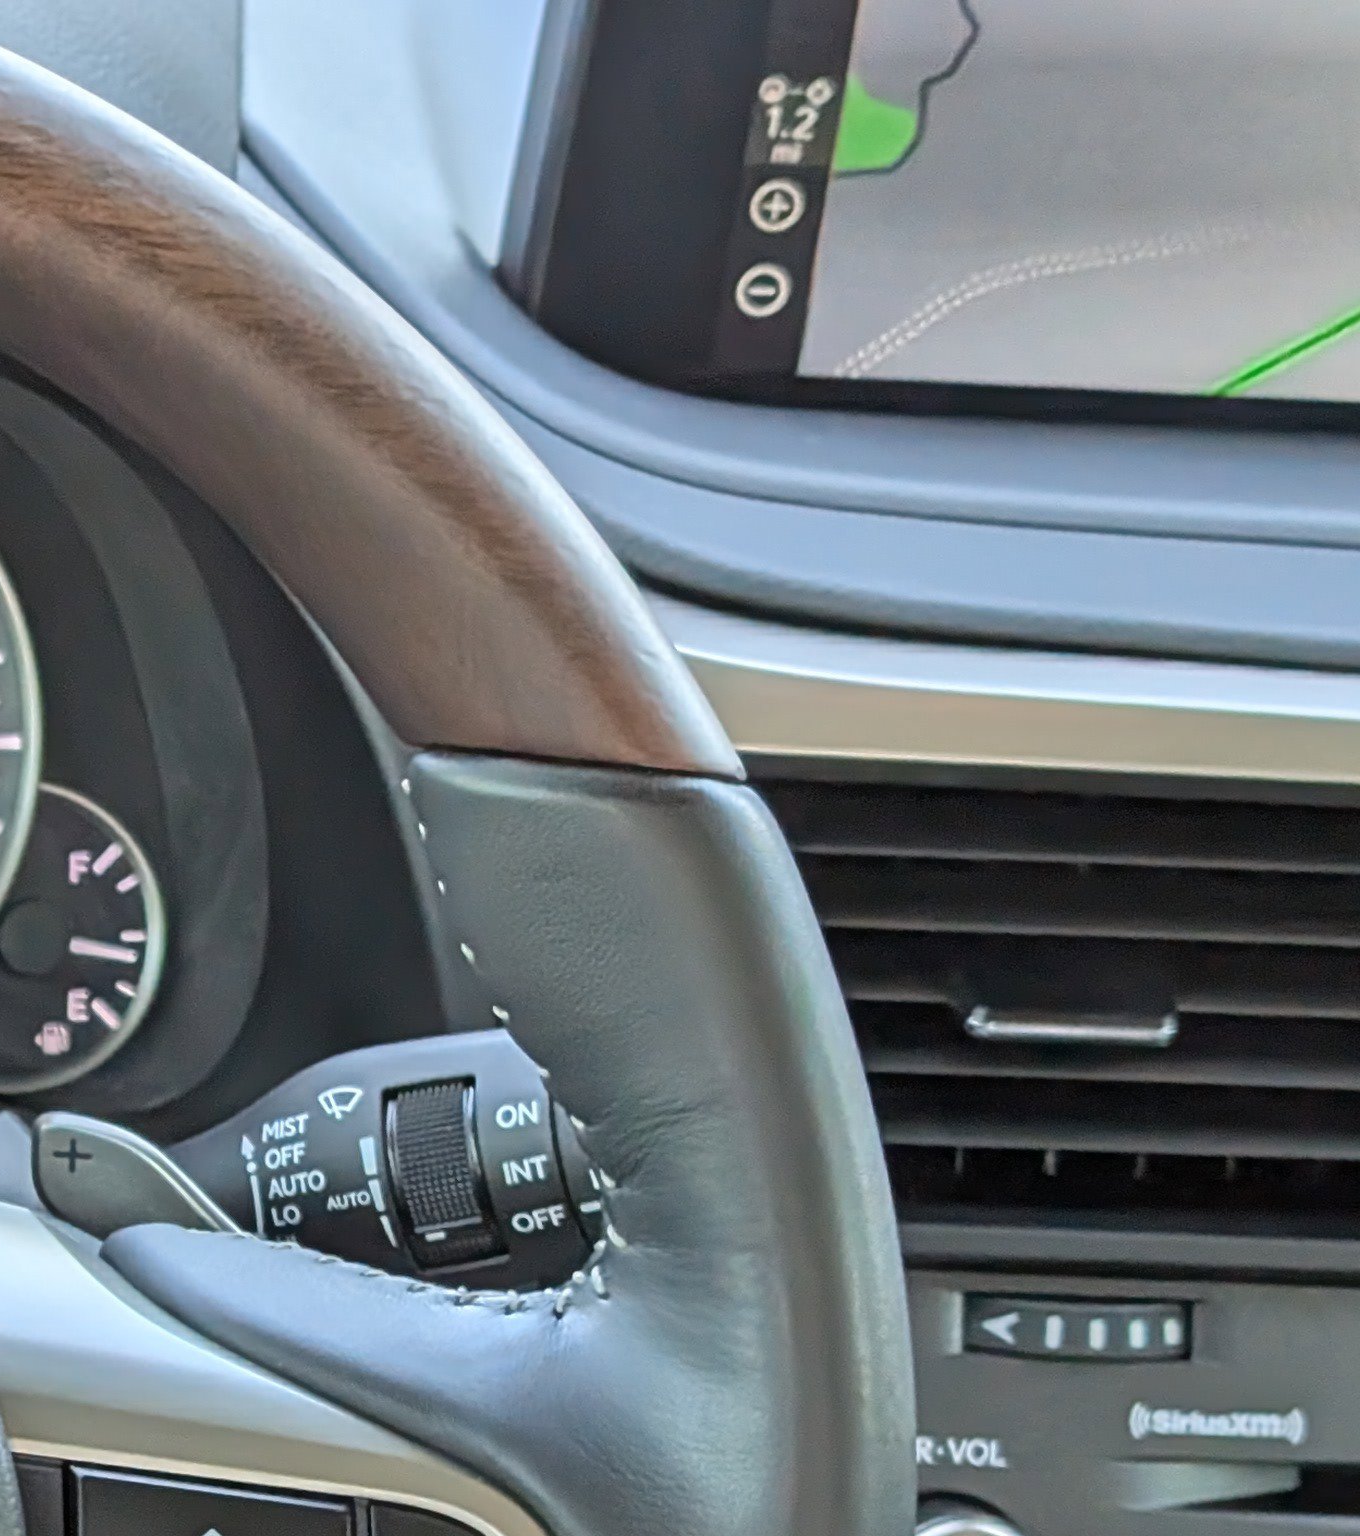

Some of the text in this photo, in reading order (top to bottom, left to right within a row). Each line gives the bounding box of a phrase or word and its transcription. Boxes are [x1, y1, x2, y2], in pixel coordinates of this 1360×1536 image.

[767, 106, 818, 141] 1.2
[69, 852, 91, 883] F
[67, 992, 89, 1022] E
[262, 1113, 308, 1142] MIST
[496, 1101, 538, 1128] ON
[265, 1142, 305, 1169] OFF
[502, 1155, 547, 1185] INT
[269, 1170, 325, 1198] AUTO
[271, 1205, 300, 1226] LO
[327, 1191, 370, 1211] AUTO
[511, 1204, 565, 1233] OFF
